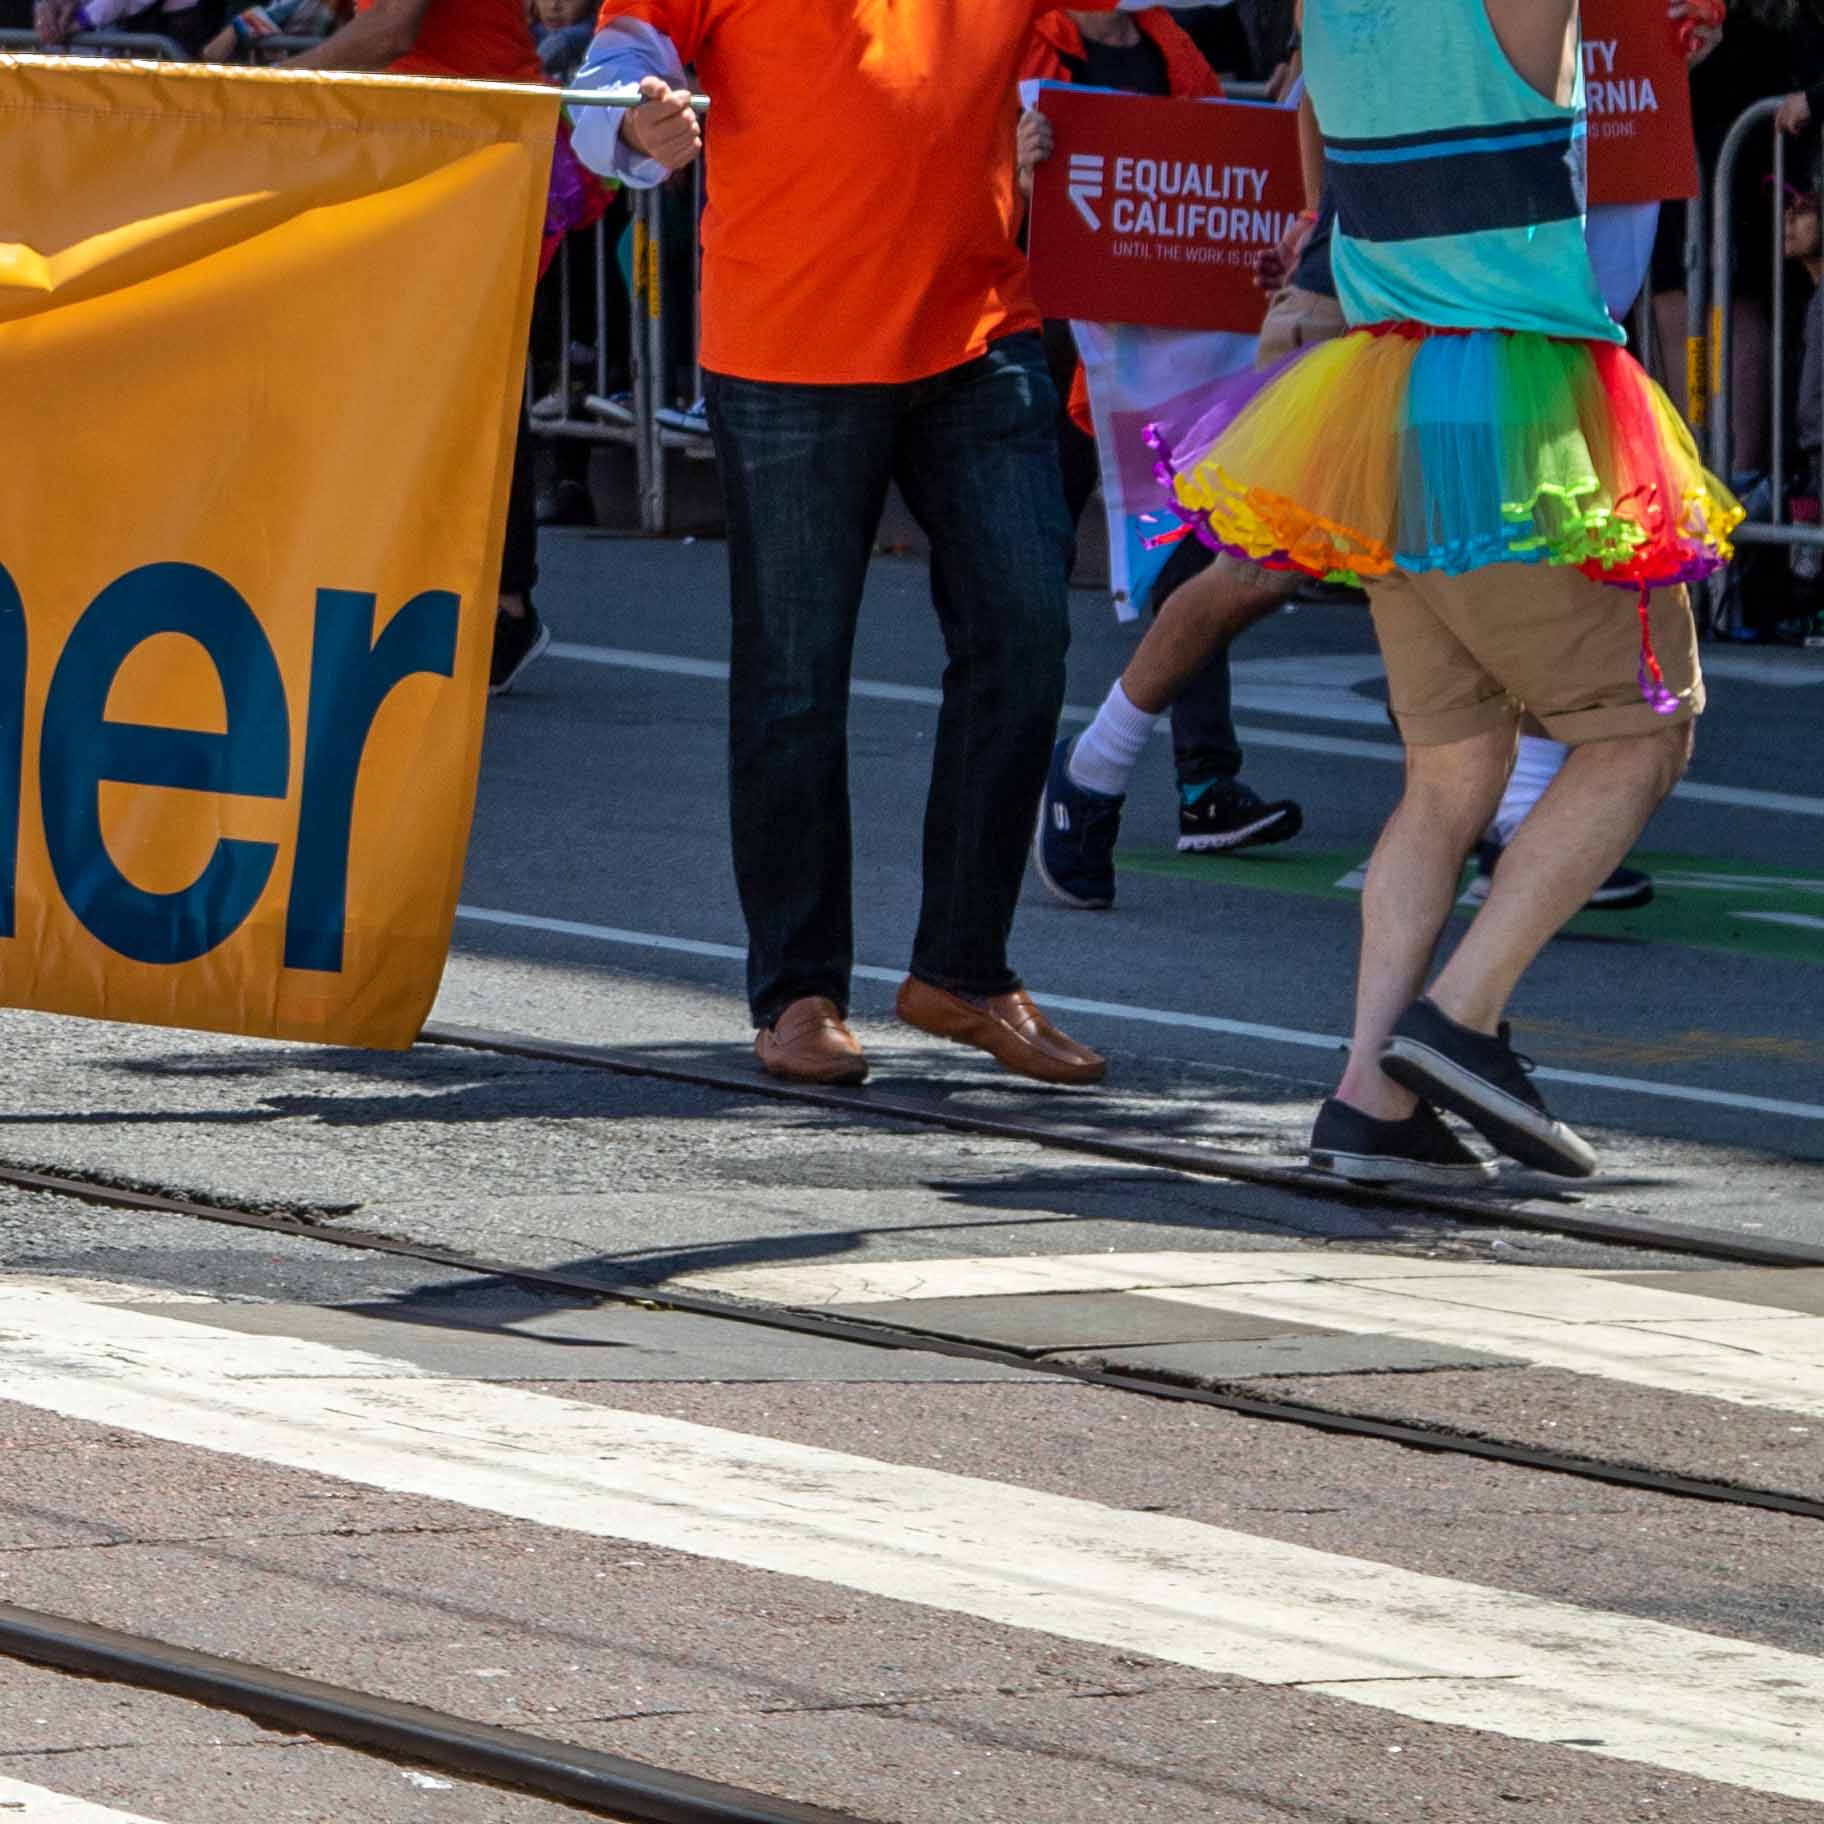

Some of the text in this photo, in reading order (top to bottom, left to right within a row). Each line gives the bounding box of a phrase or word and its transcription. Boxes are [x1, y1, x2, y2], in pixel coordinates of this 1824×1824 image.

[1114, 157, 1268, 203] EQUALITY
[1112, 240, 1153, 259] UNTIL
[1155, 242, 1179, 261] THE
[1185, 245, 1225, 265] WORK
[1228, 249, 1241, 266] IS
